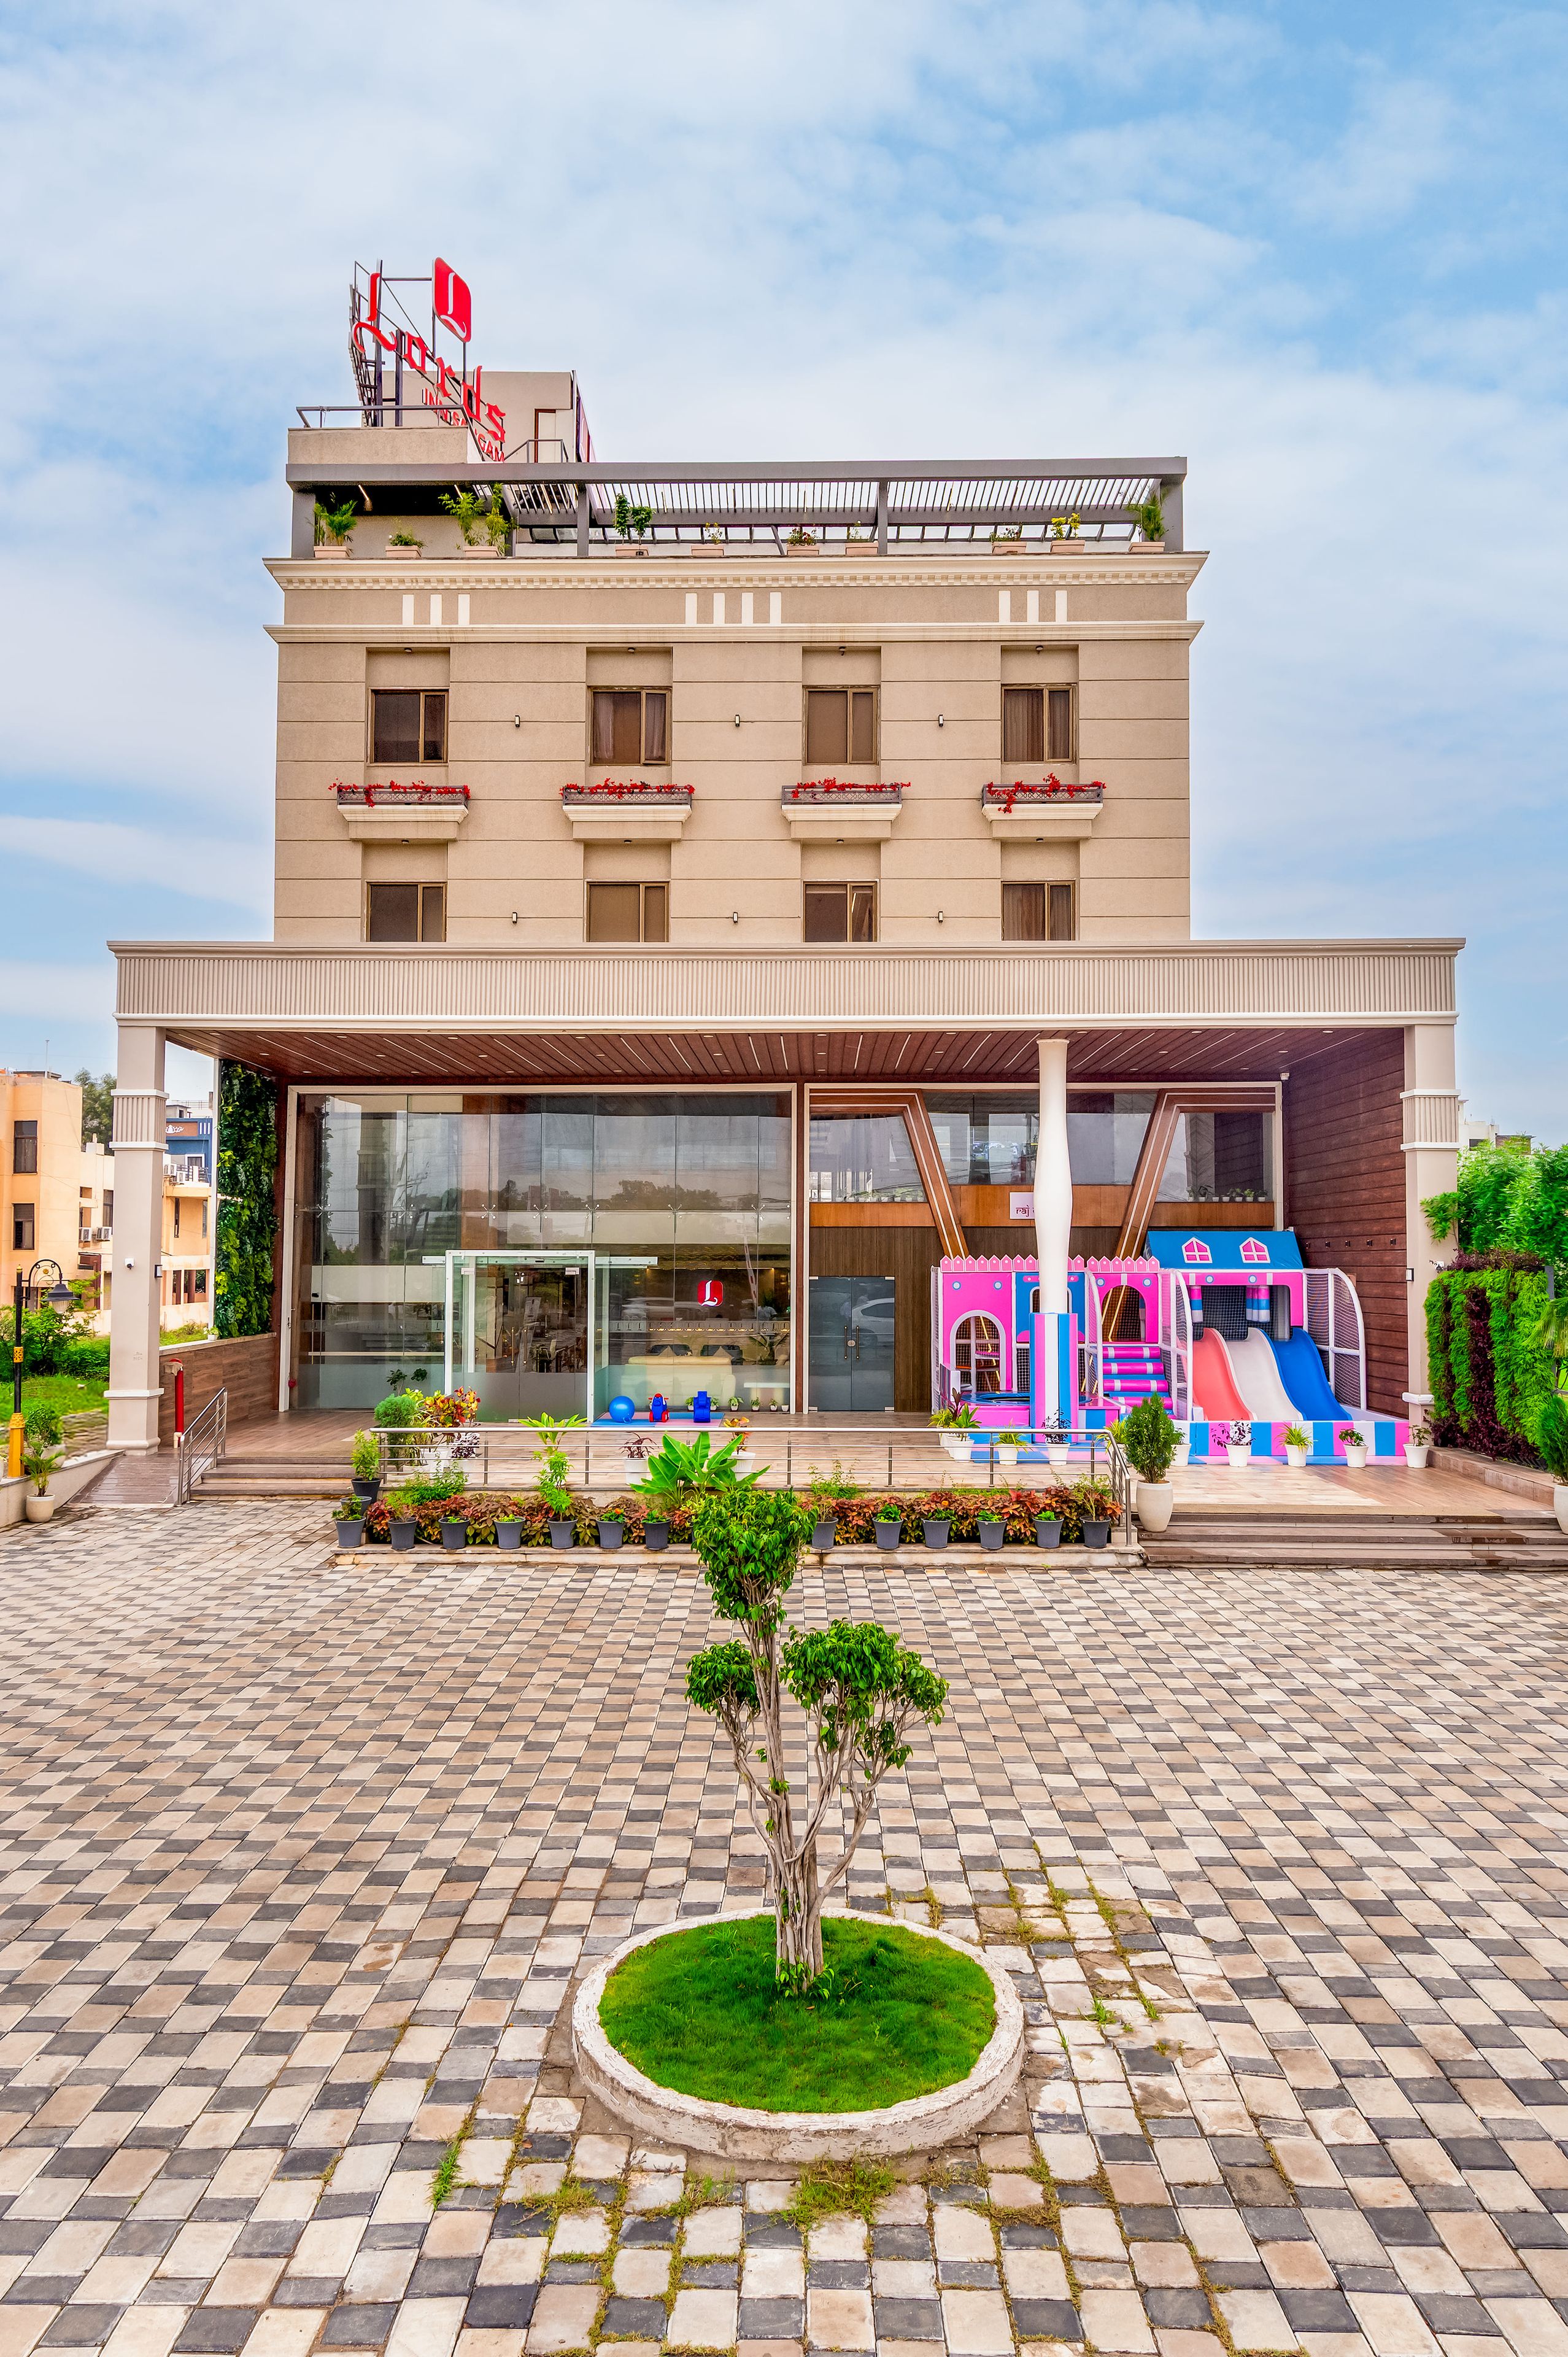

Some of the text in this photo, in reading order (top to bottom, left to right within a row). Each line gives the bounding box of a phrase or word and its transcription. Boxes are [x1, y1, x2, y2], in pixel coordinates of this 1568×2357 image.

[352, 272, 506, 443] Lords
[1016, 1204, 1030, 1217] raj
[701, 1280, 718, 1306] L
